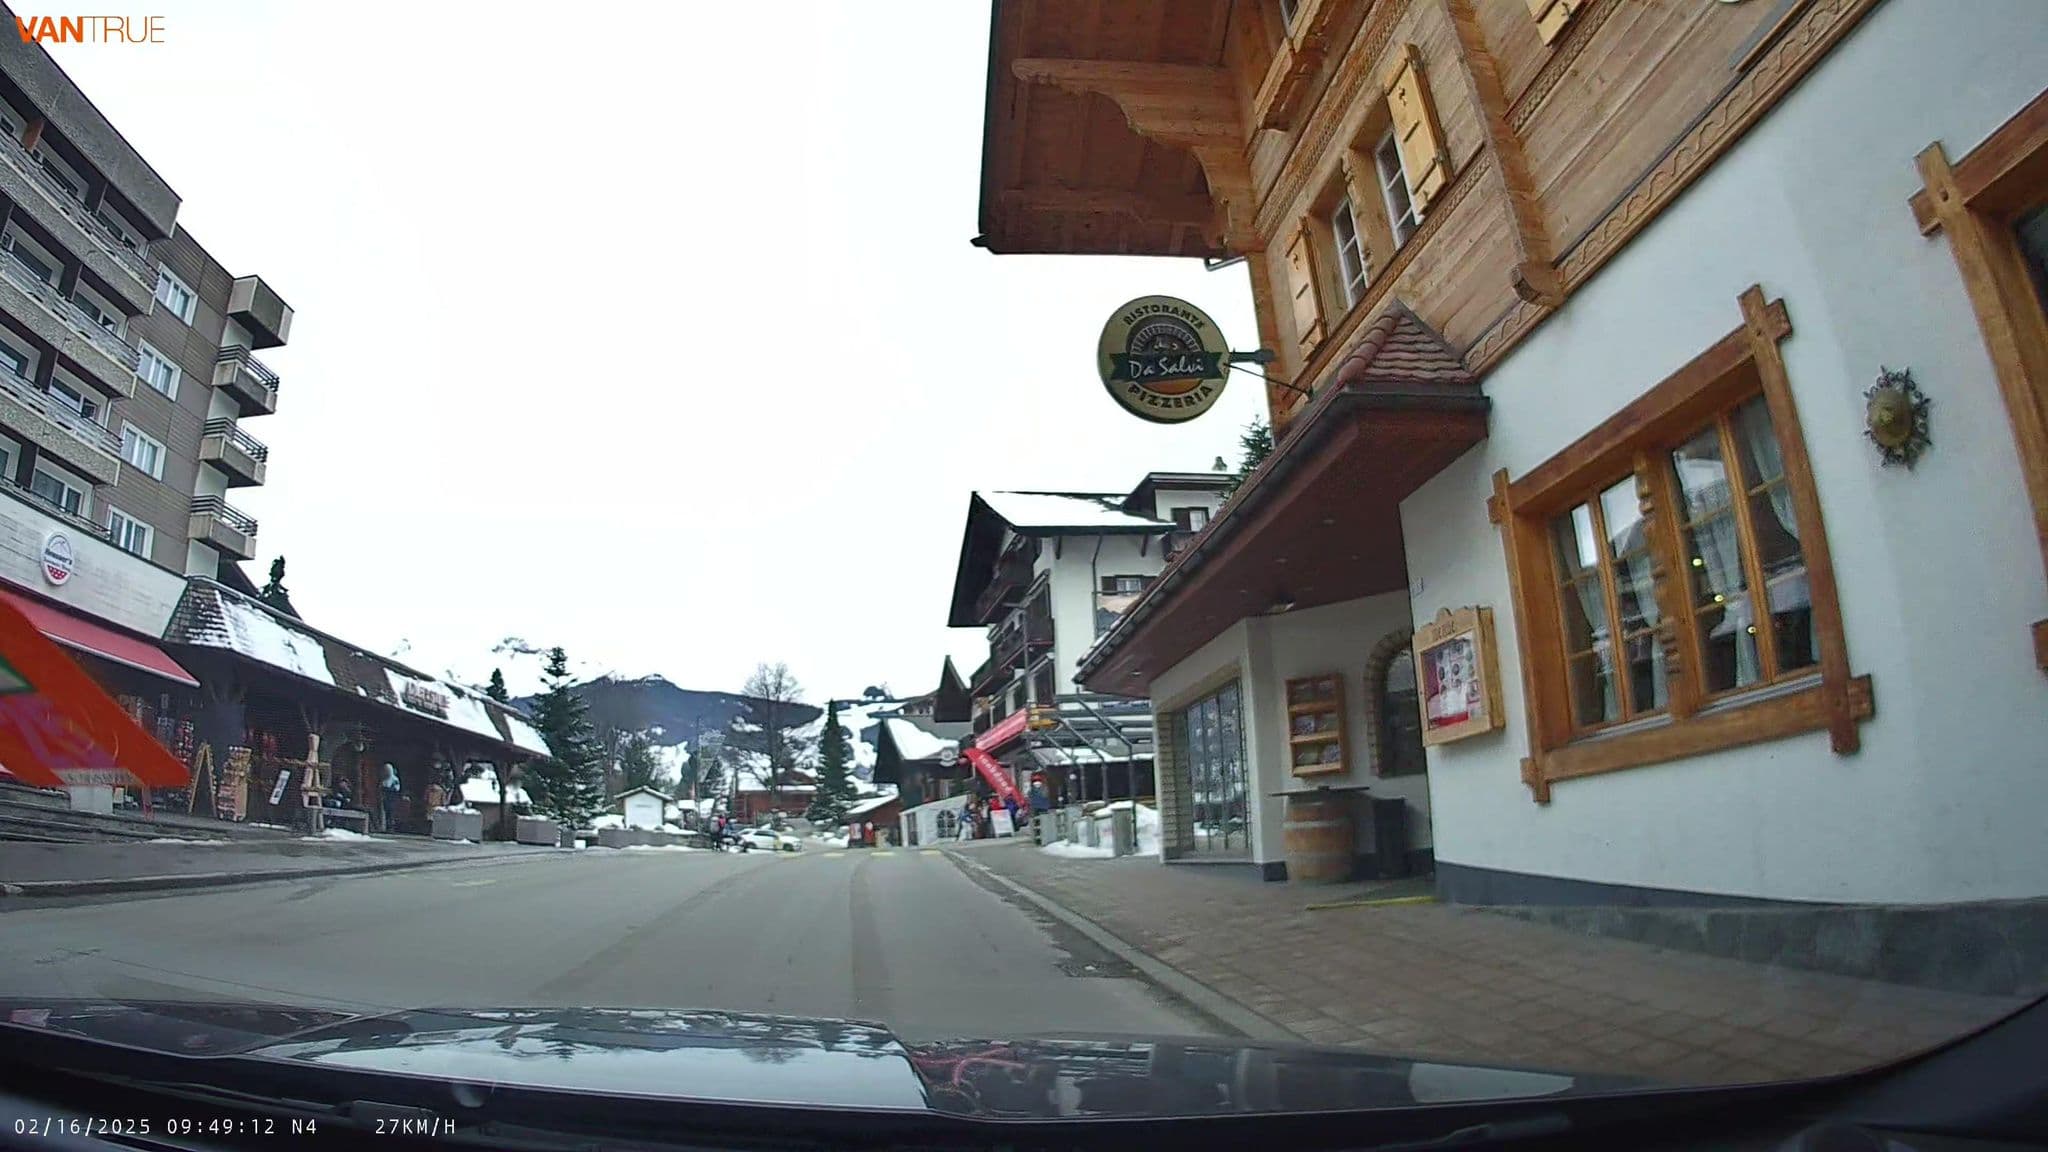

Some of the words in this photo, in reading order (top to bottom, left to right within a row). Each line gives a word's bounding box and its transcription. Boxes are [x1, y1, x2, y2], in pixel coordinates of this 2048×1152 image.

[1128, 360, 1155, 379] Da
[1159, 356, 1204, 376] Salvi
[1127, 383, 1213, 409] PIZZERIA
